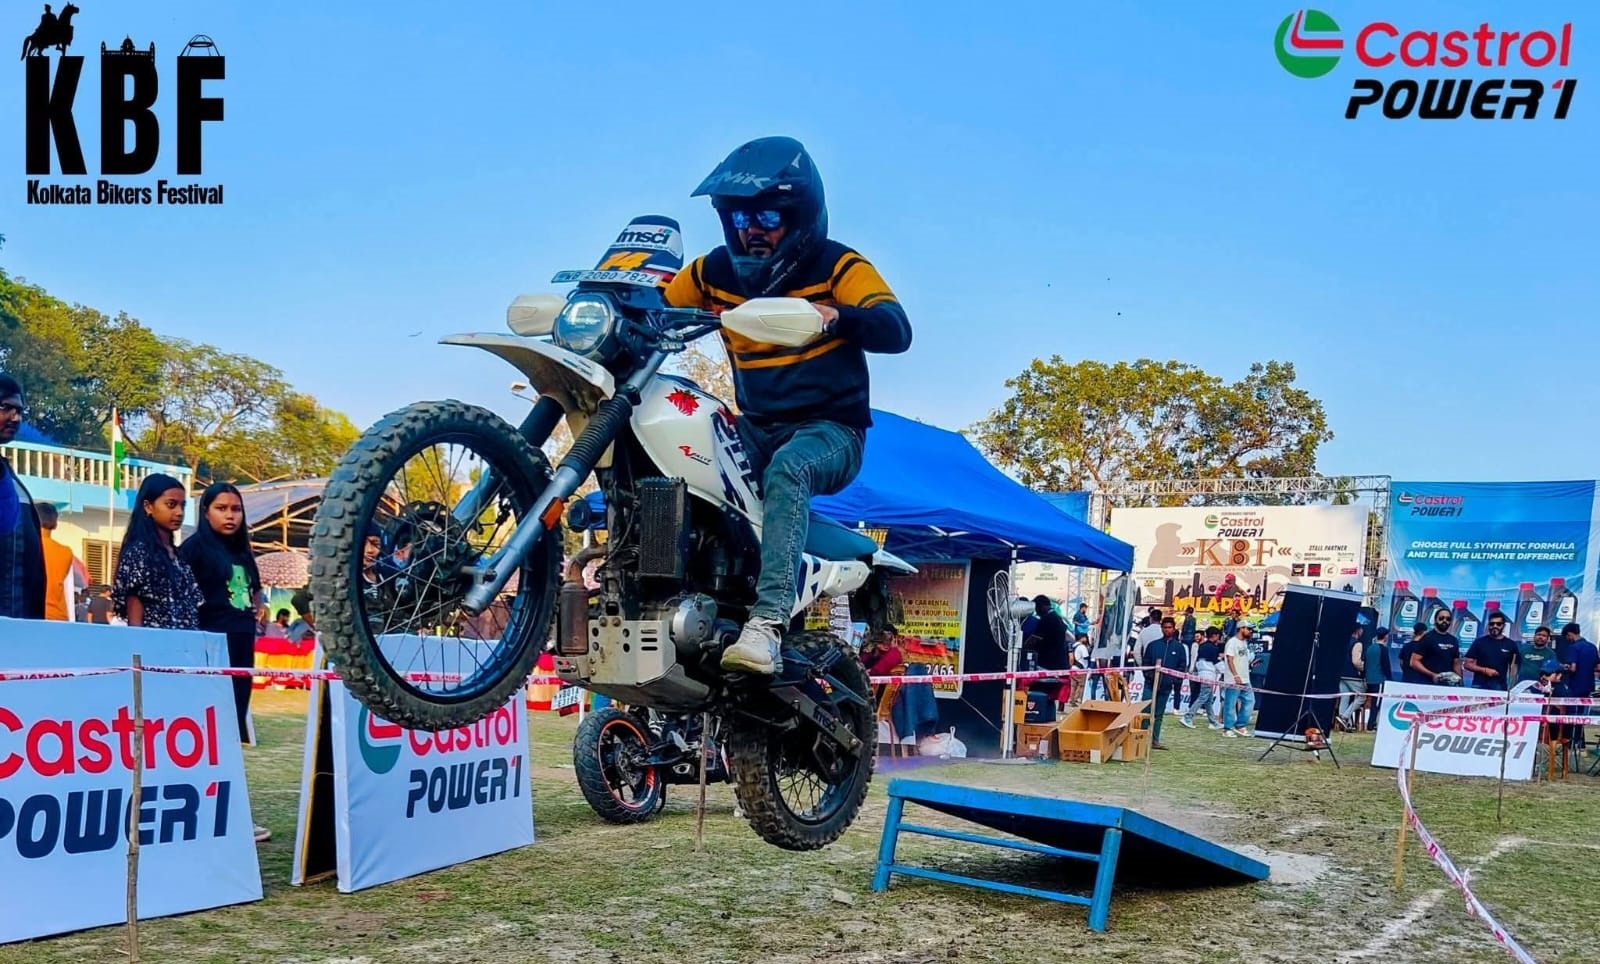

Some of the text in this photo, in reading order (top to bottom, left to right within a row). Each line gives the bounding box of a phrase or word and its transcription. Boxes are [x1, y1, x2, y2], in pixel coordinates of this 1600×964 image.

[1415, 494, 1464, 505] Castrol
[1220, 516, 1264, 527] Castrol
[1411, 540, 1575, 550] CHOOSE FULL SYNTHETIC FORMULA
[1193, 538, 1279, 567] KBF
[1407, 551, 1576, 560] AND FEEL THE ULTIMATE DIFFERENCE
[1173, 595, 1233, 613] MILAP
